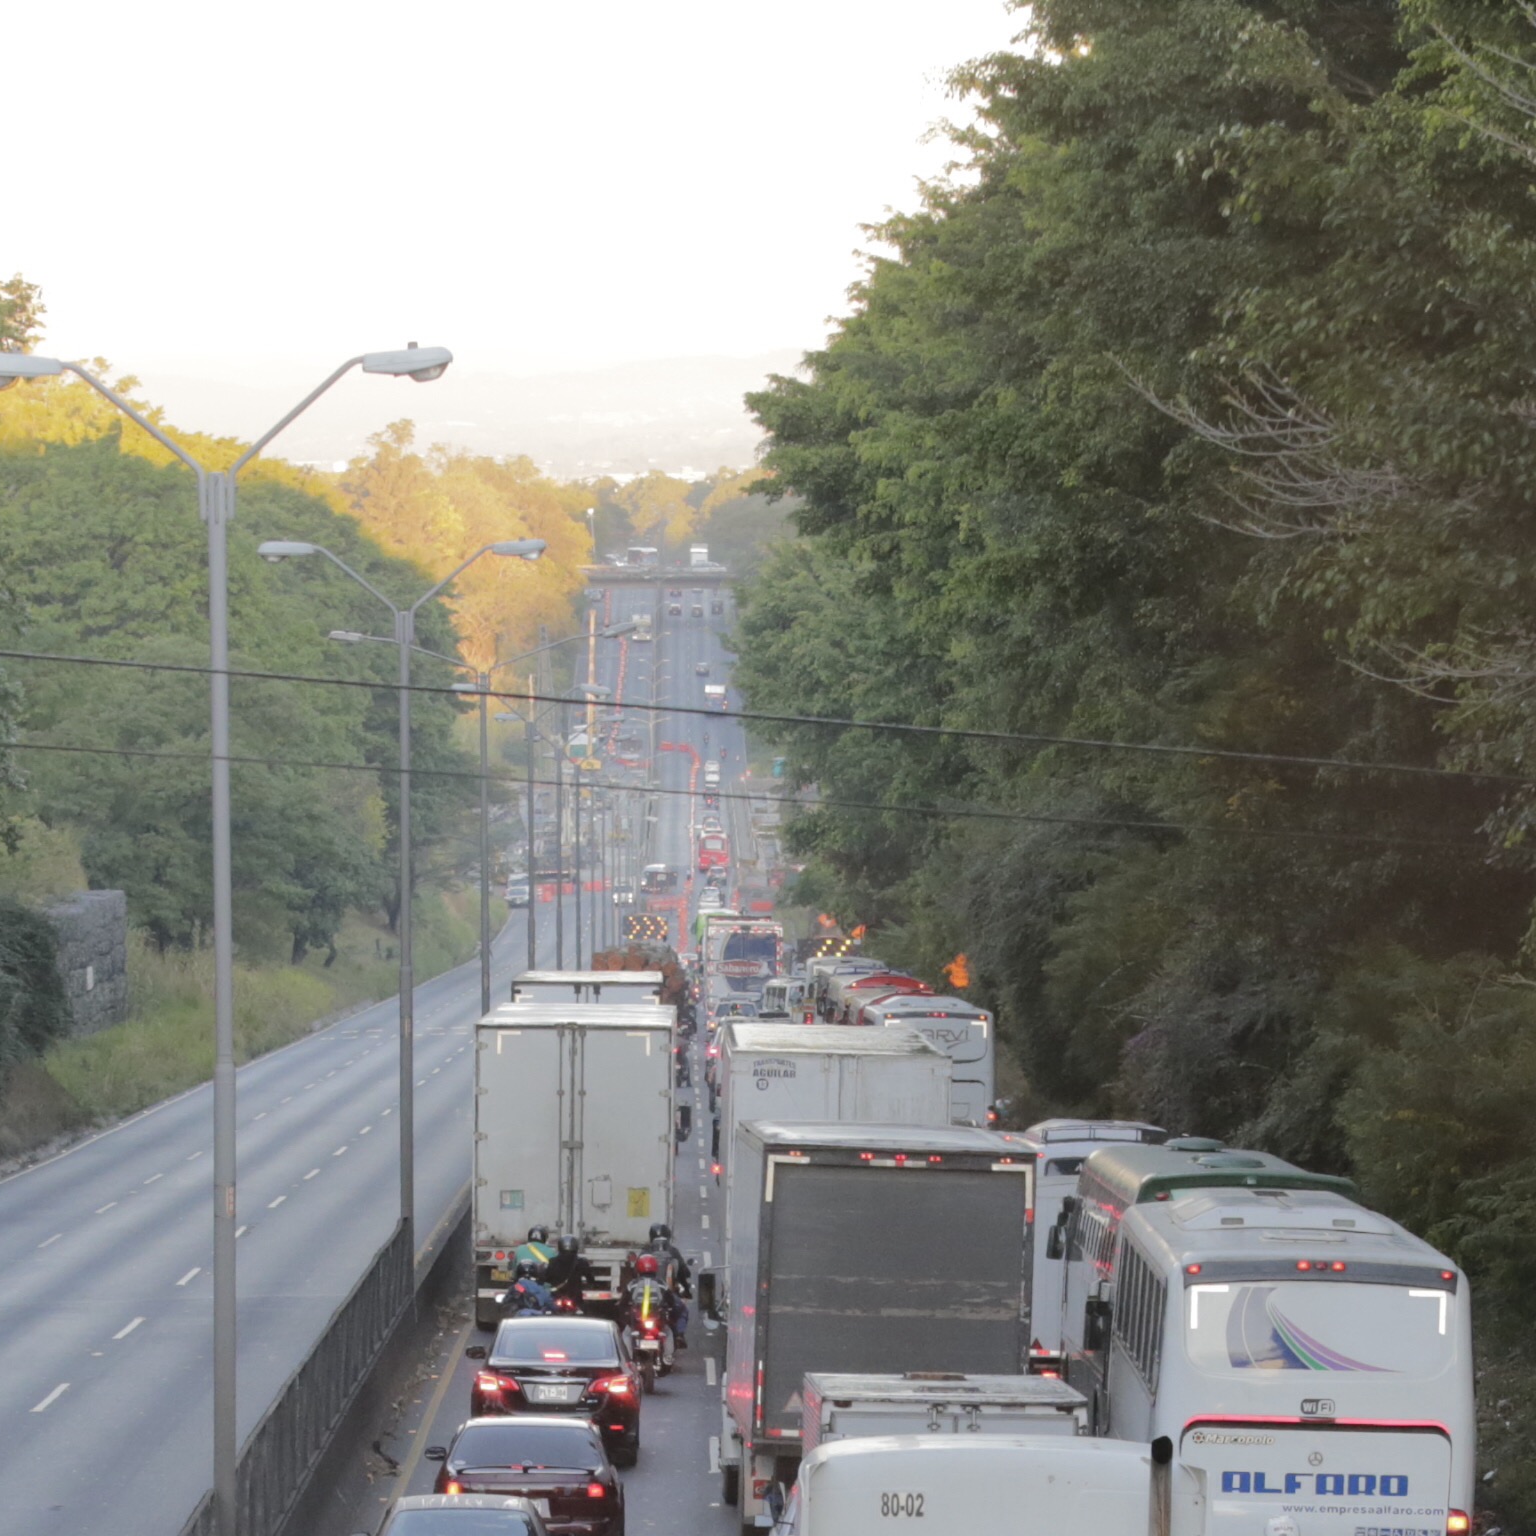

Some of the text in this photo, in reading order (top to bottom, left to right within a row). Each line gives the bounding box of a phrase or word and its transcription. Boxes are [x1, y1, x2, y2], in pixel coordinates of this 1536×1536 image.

[752, 1069, 797, 1079] AGUILAR
[1205, 1434, 1275, 1446] Marcopolo
[1221, 1471, 1409, 1497] ALFARO
[881, 1492, 924, 1517] 80-02
[1282, 1504, 1445, 1516] www.empresaalfaro.com
